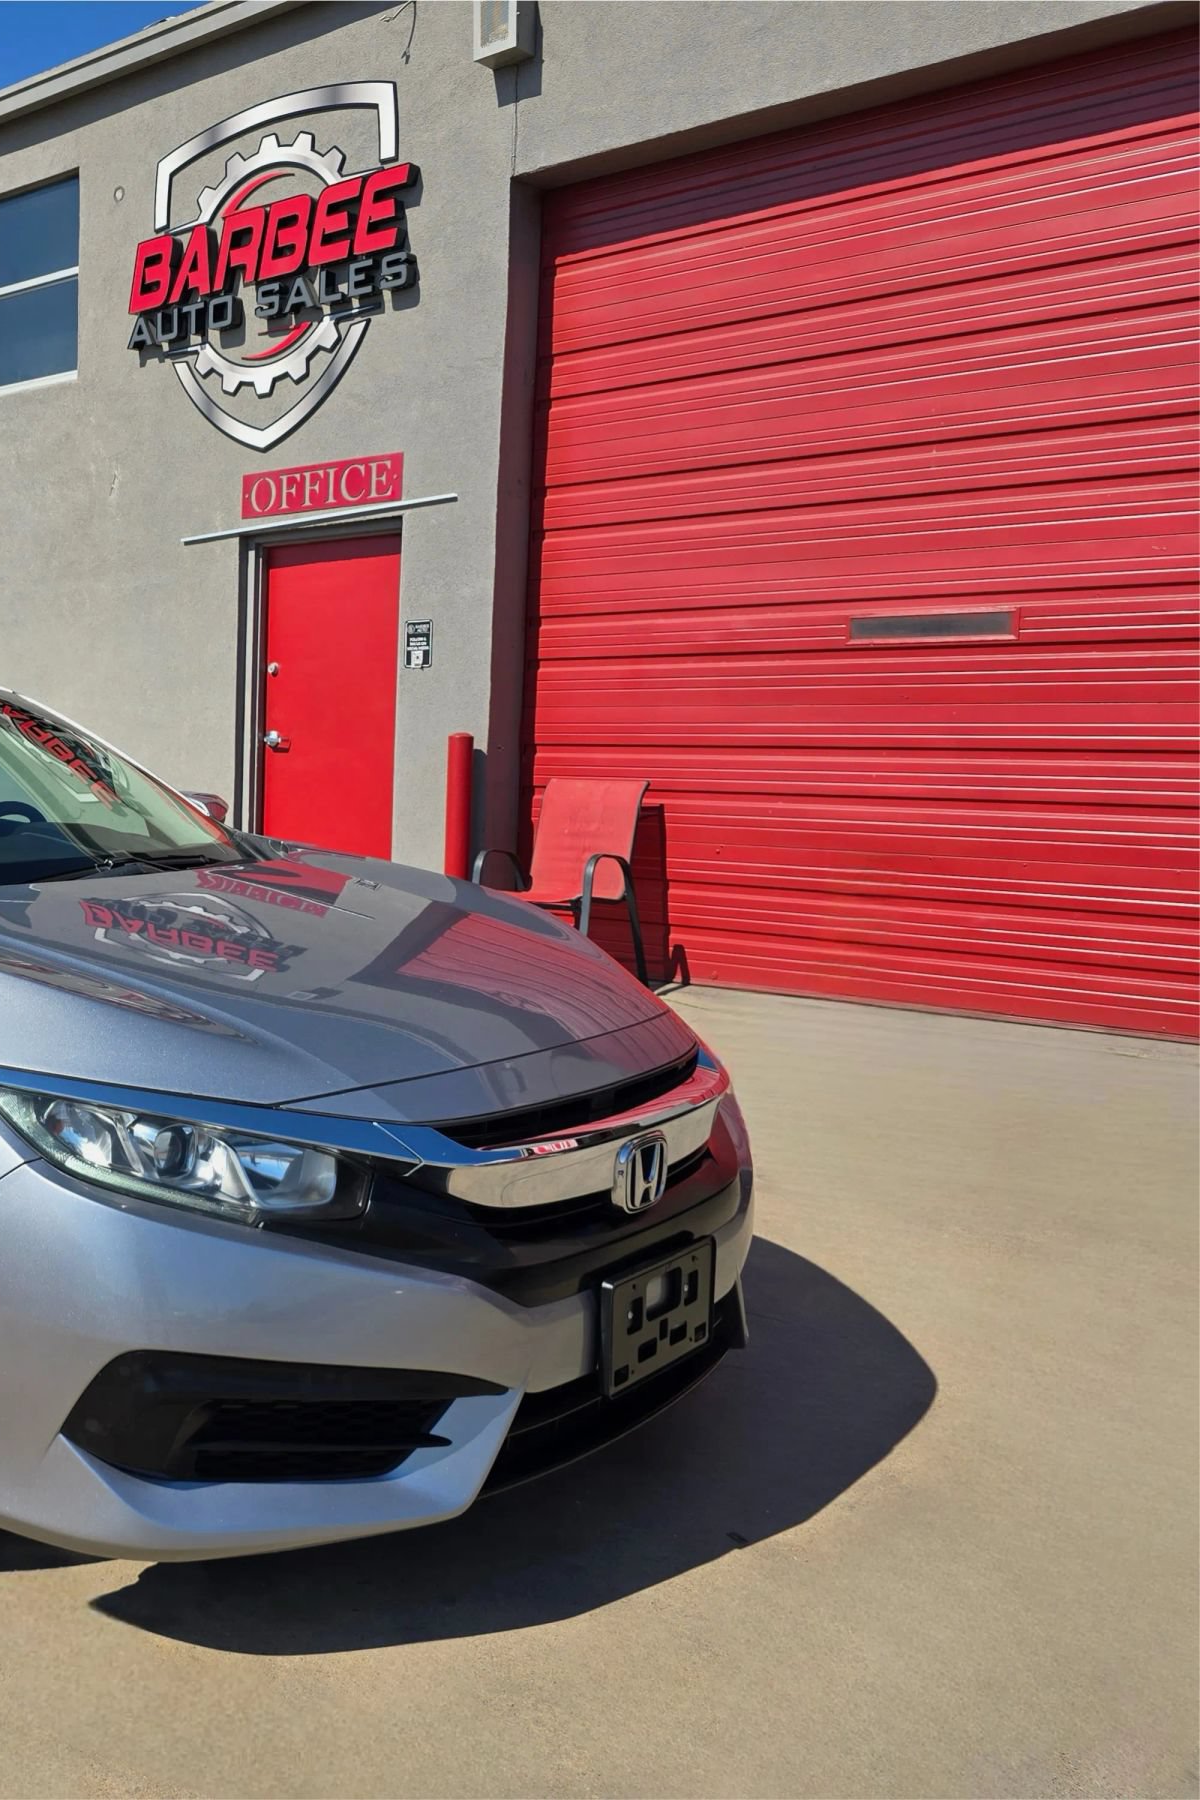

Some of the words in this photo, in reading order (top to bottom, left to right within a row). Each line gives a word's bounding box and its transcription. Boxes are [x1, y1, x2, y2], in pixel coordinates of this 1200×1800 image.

[128, 162, 414, 314] BARBEE
[127, 294, 237, 350] AUTO
[254, 250, 412, 319] SALES
[250, 459, 393, 513] OFFICE
